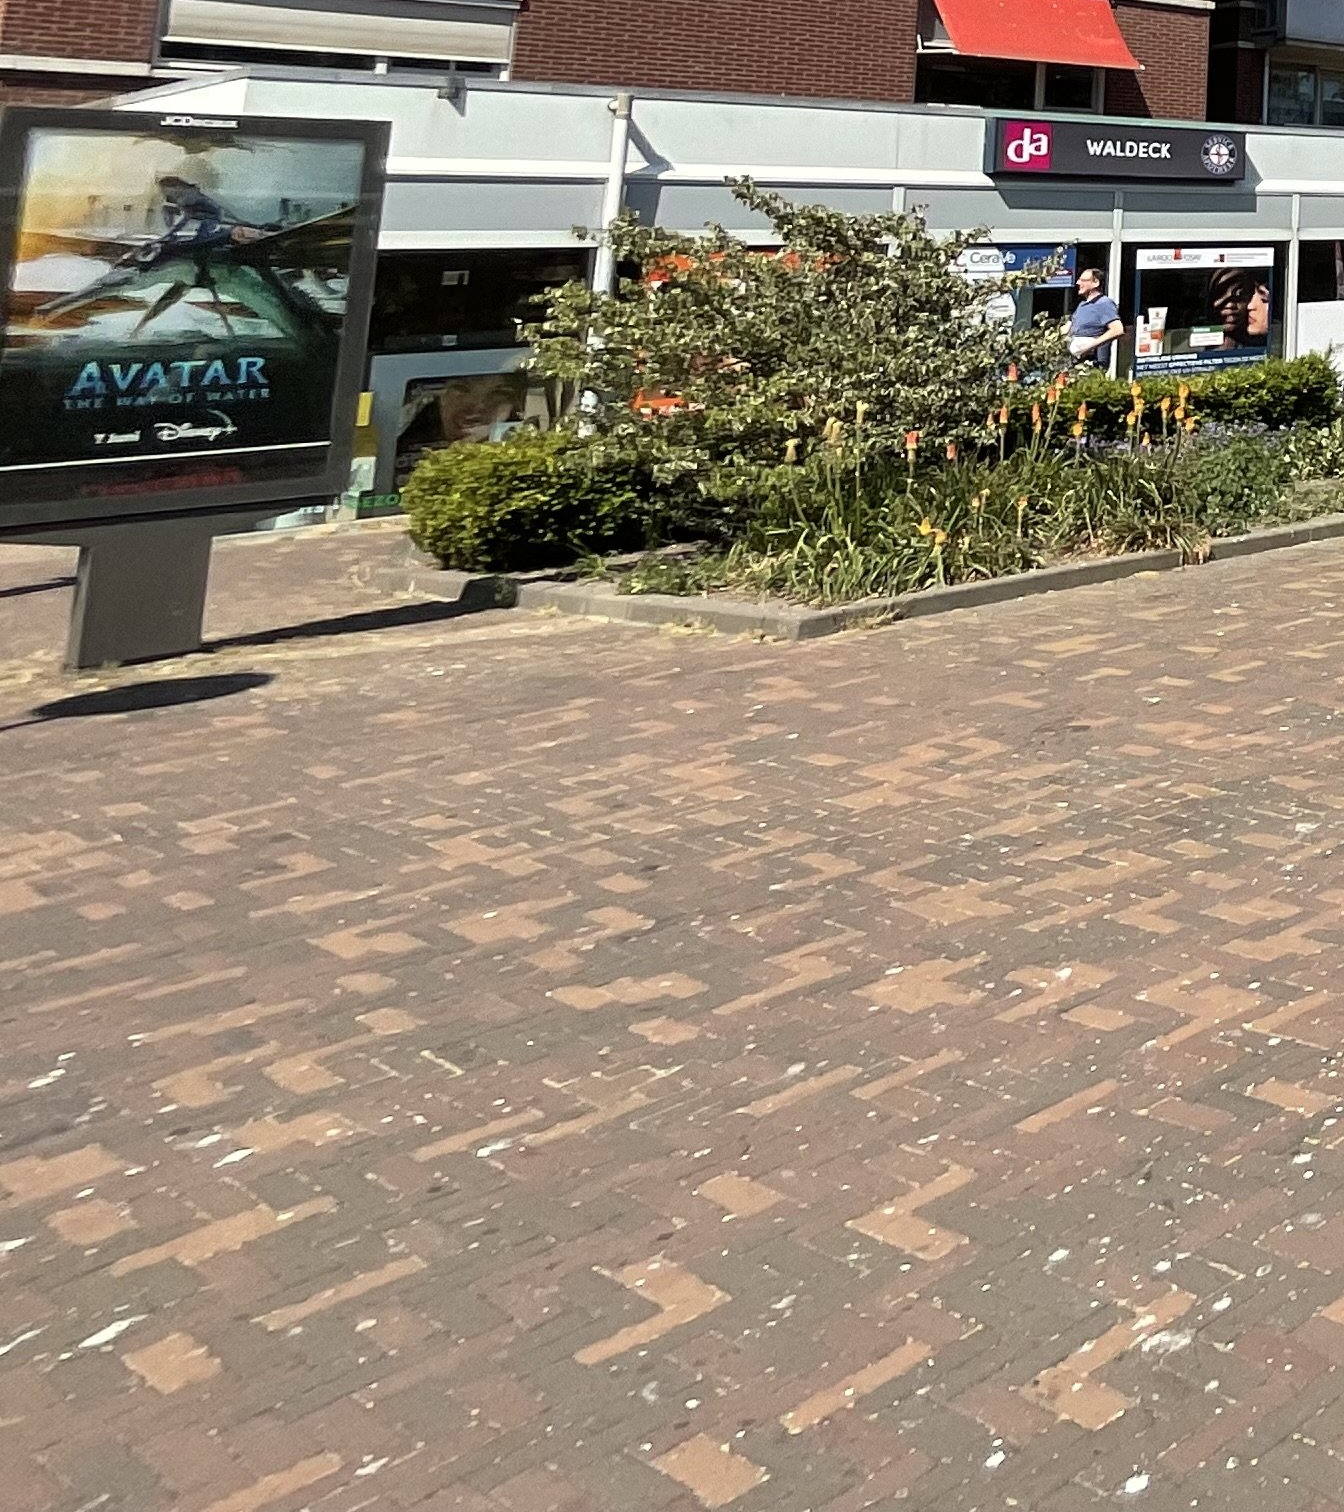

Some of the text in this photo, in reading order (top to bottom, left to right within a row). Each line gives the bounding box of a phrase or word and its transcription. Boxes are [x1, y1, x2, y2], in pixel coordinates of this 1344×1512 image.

[1007, 128, 1048, 163] da
[1086, 139, 1171, 159] WALDECK
[66, 356, 270, 396] AVATAR
[63, 397, 104, 410] THE
[168, 392, 196, 404] OF
[206, 388, 271, 402] WATER
